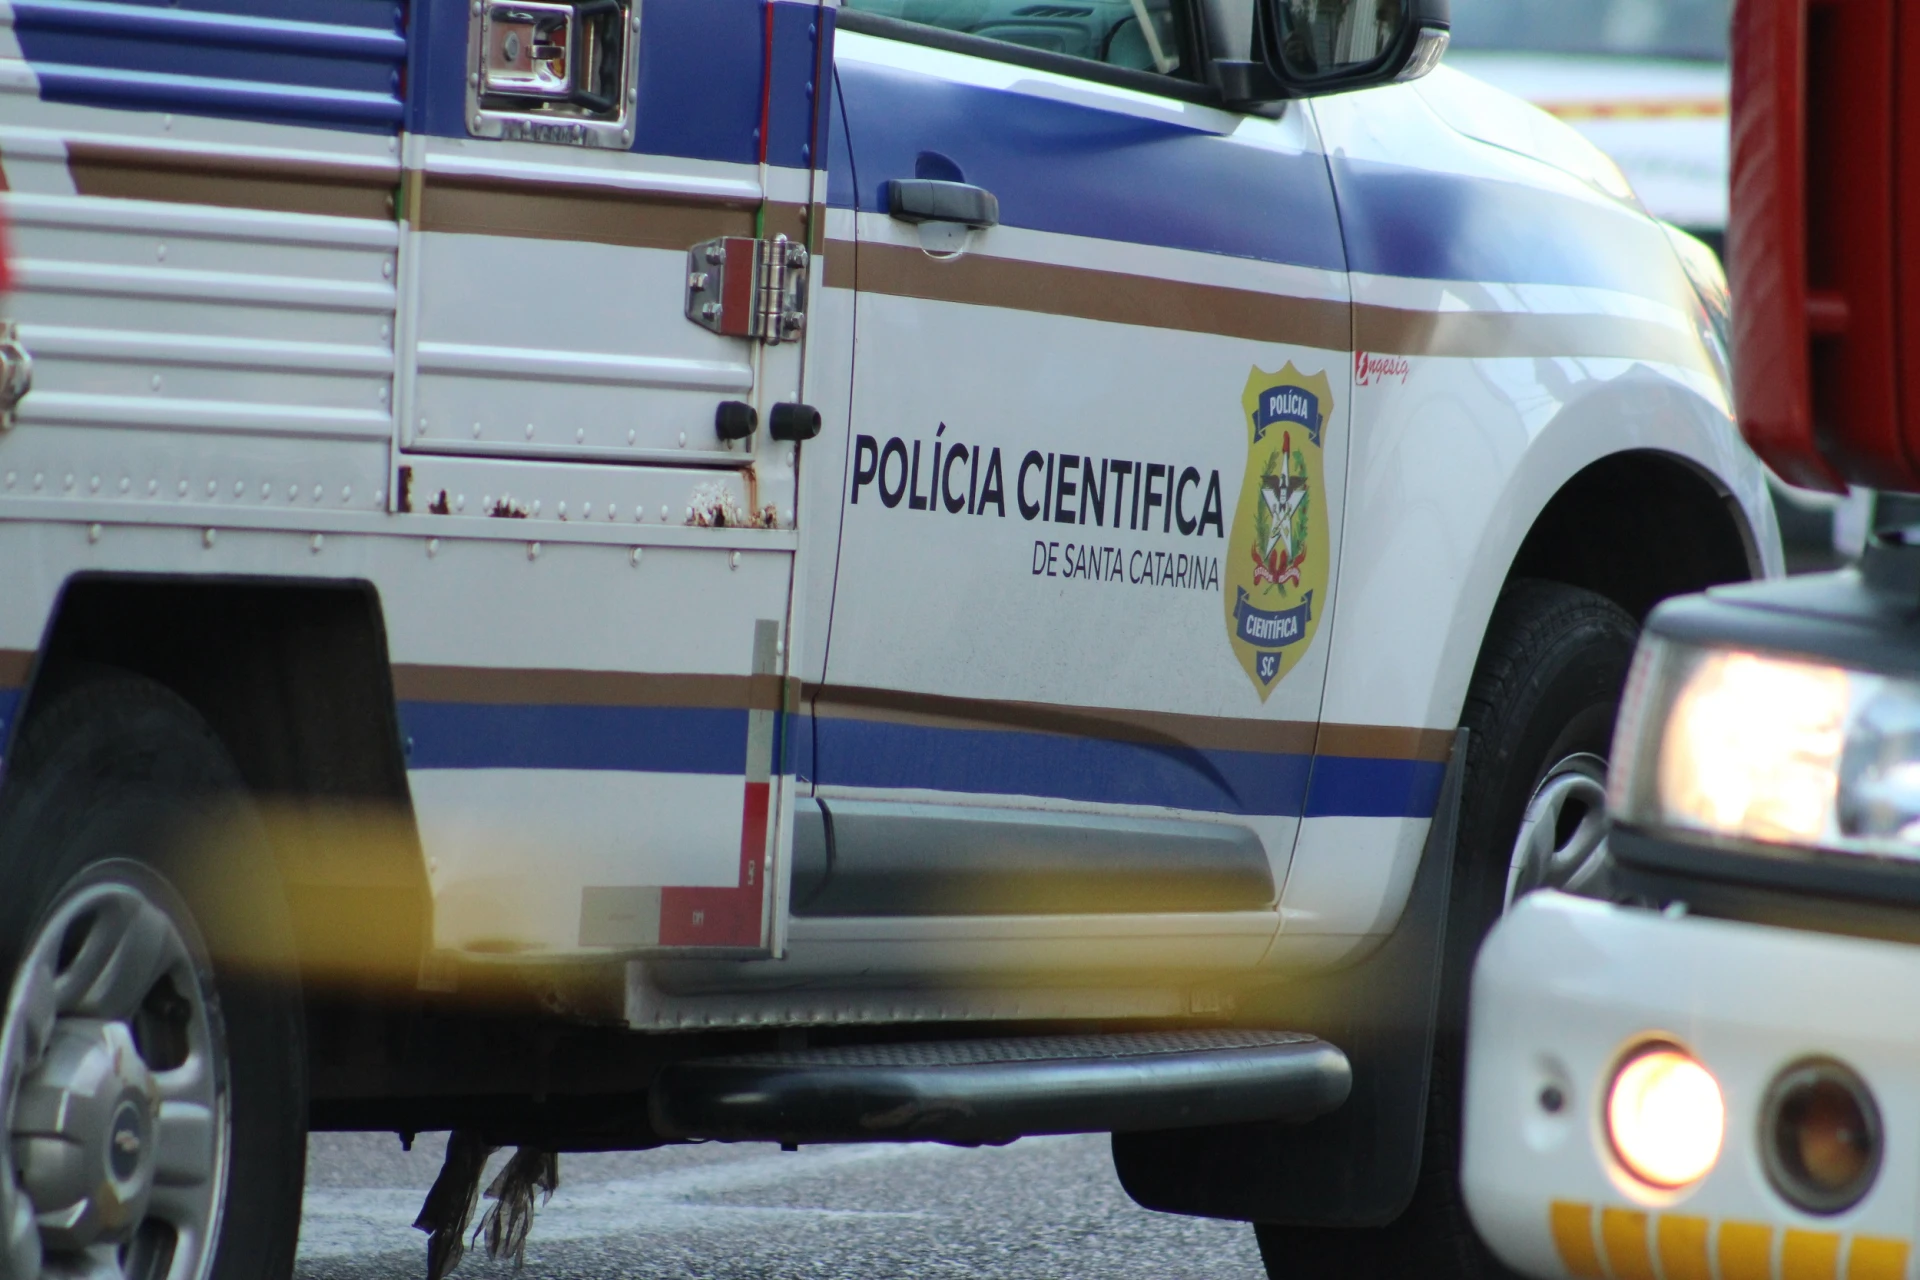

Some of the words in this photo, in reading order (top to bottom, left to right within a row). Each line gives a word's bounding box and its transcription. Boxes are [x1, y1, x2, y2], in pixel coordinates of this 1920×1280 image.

[1269, 389, 1308, 419] POLÍCIA
[851, 421, 1005, 517] POLÍCIA
[1016, 450, 1224, 538] CIENTIFICA
[1032, 540, 1059, 577] DE
[1062, 543, 1124, 583] SANTA
[1129, 550, 1219, 592] CATARINA
[1246, 614, 1298, 640] CIENTÍFICA
[1260, 656, 1275, 677] SC
